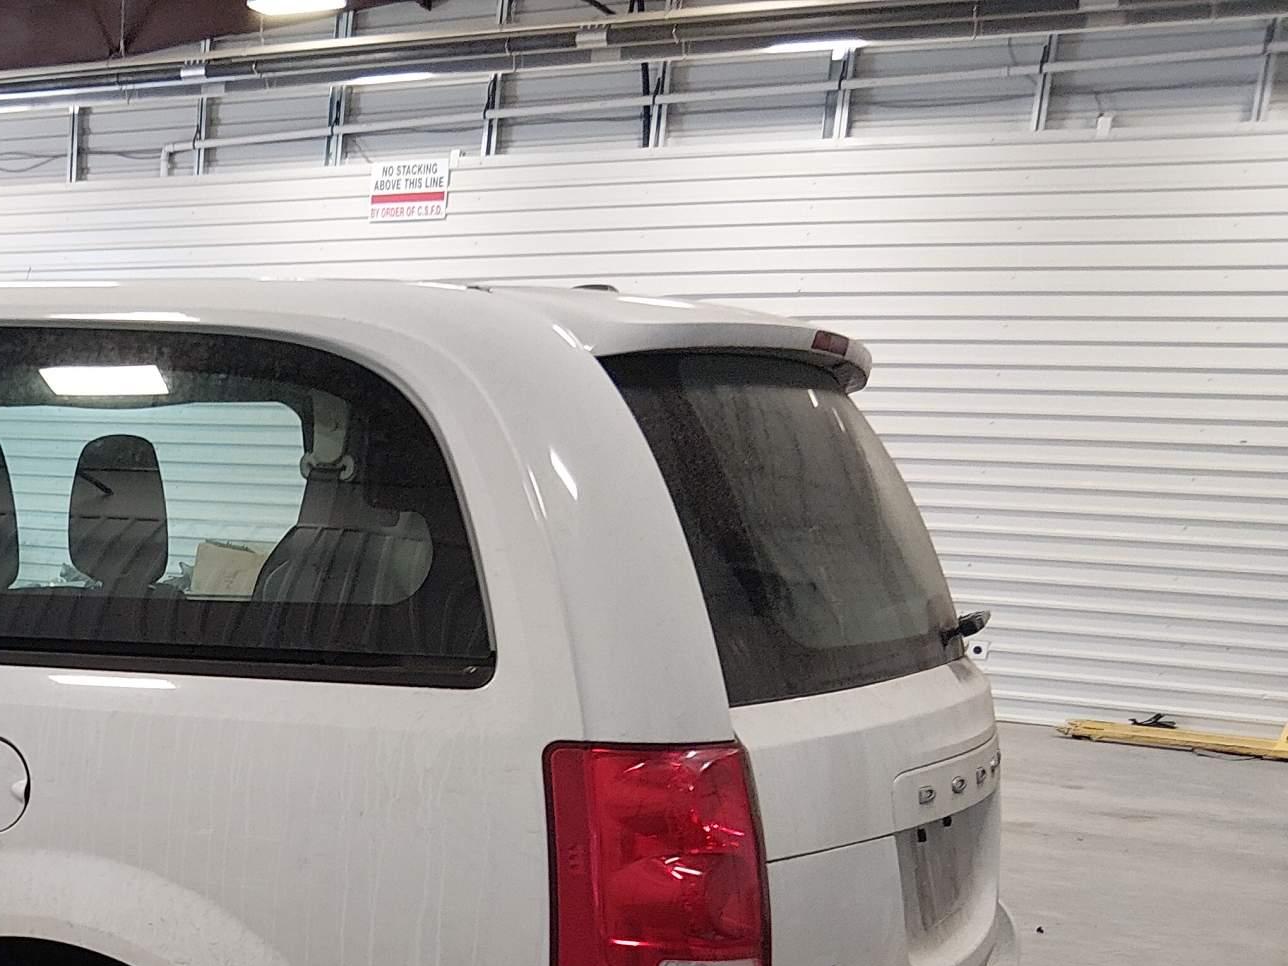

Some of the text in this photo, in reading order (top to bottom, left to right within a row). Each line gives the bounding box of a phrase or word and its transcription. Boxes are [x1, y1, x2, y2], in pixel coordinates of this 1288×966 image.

[382, 162, 438, 177] NO STACKING
[374, 176, 444, 191] ABOVE THIS LINE
[371, 208, 380, 218] BY
[381, 207, 405, 218] ORDER
[406, 206, 415, 217] OF
